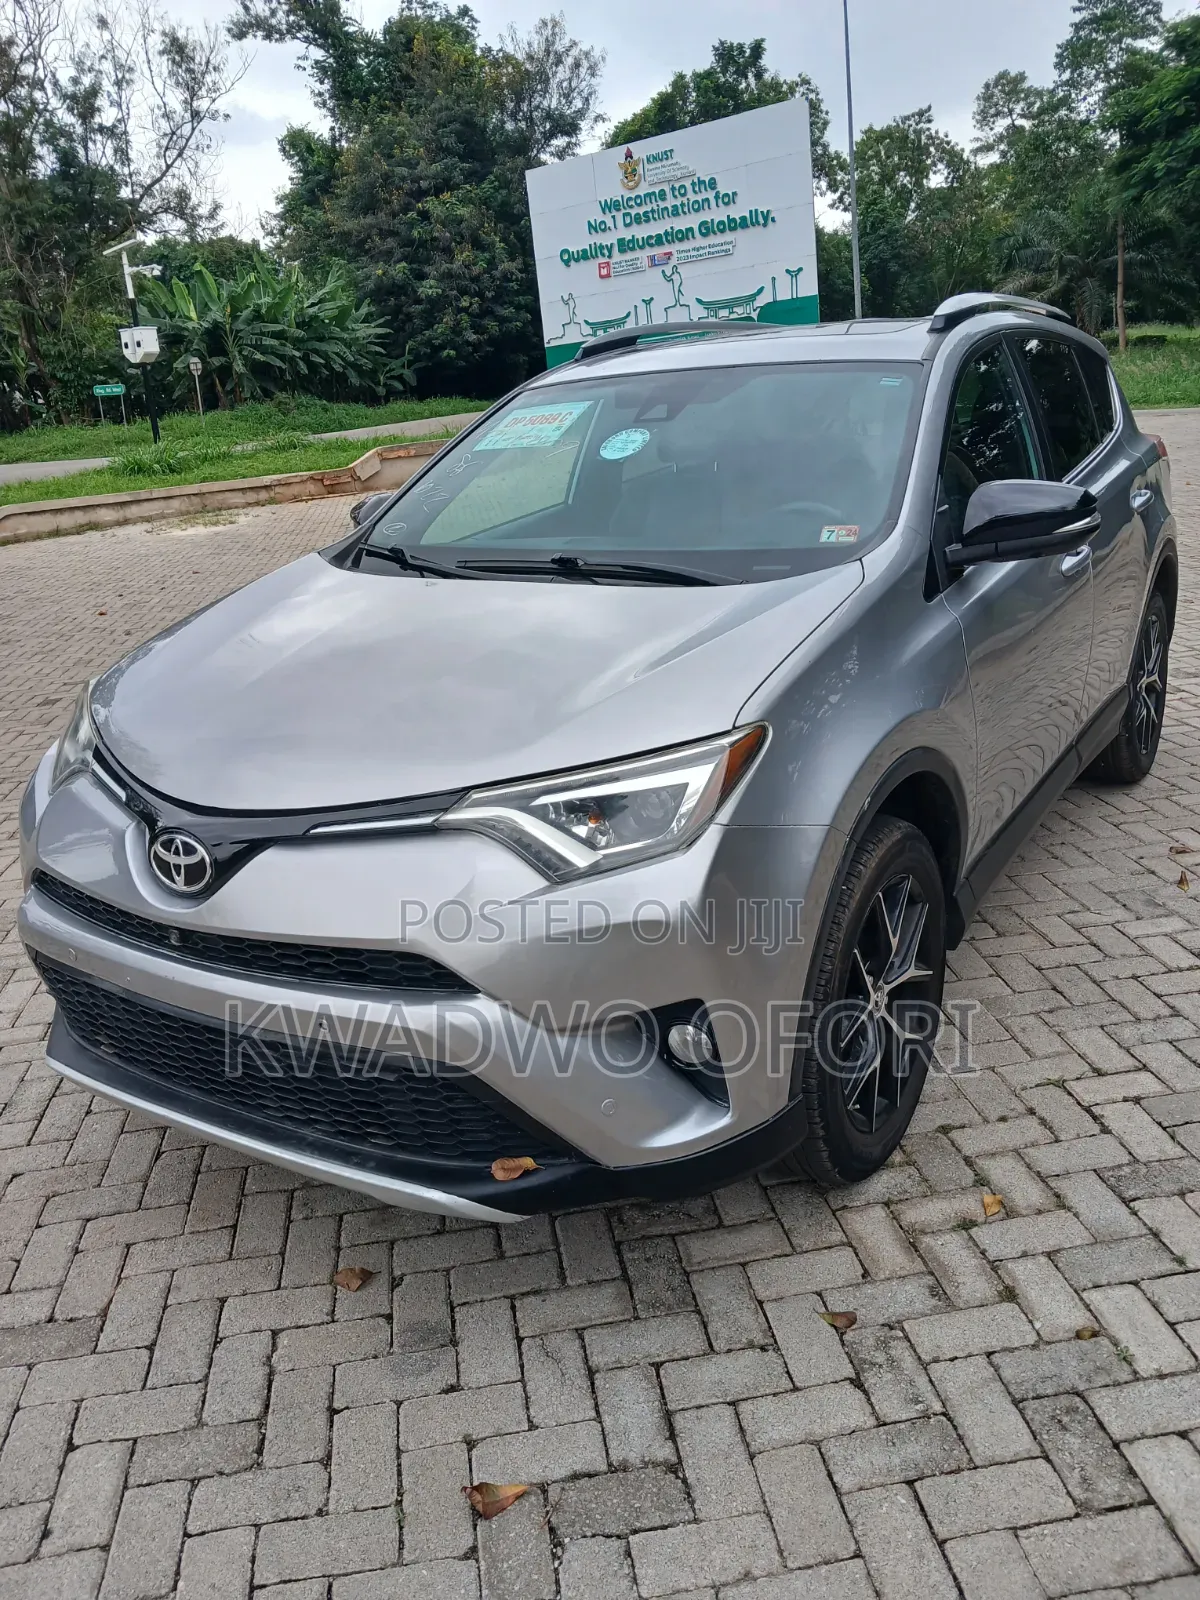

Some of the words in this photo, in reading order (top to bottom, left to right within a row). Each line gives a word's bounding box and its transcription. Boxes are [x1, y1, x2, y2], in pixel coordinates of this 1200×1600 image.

[646, 148, 674, 165] KNUST
[599, 188, 667, 214] Welcome
[670, 184, 687, 198] to
[691, 176, 718, 194] the
[587, 214, 618, 234] No.1
[622, 199, 711, 228] Destination
[714, 190, 738, 207] for
[560, 242, 616, 268] Quality
[617, 226, 696, 254] Education
[698, 208, 776, 238] Globally.
[690, 252, 706, 260] Impact
[707, 247, 731, 258] Rankings
[692, 244, 708, 254] Higher
[708, 240, 734, 249] Education
[504, 416, 528, 428] DP
[826, 530, 836, 540] 7
[846, 528, 858, 536] 24
